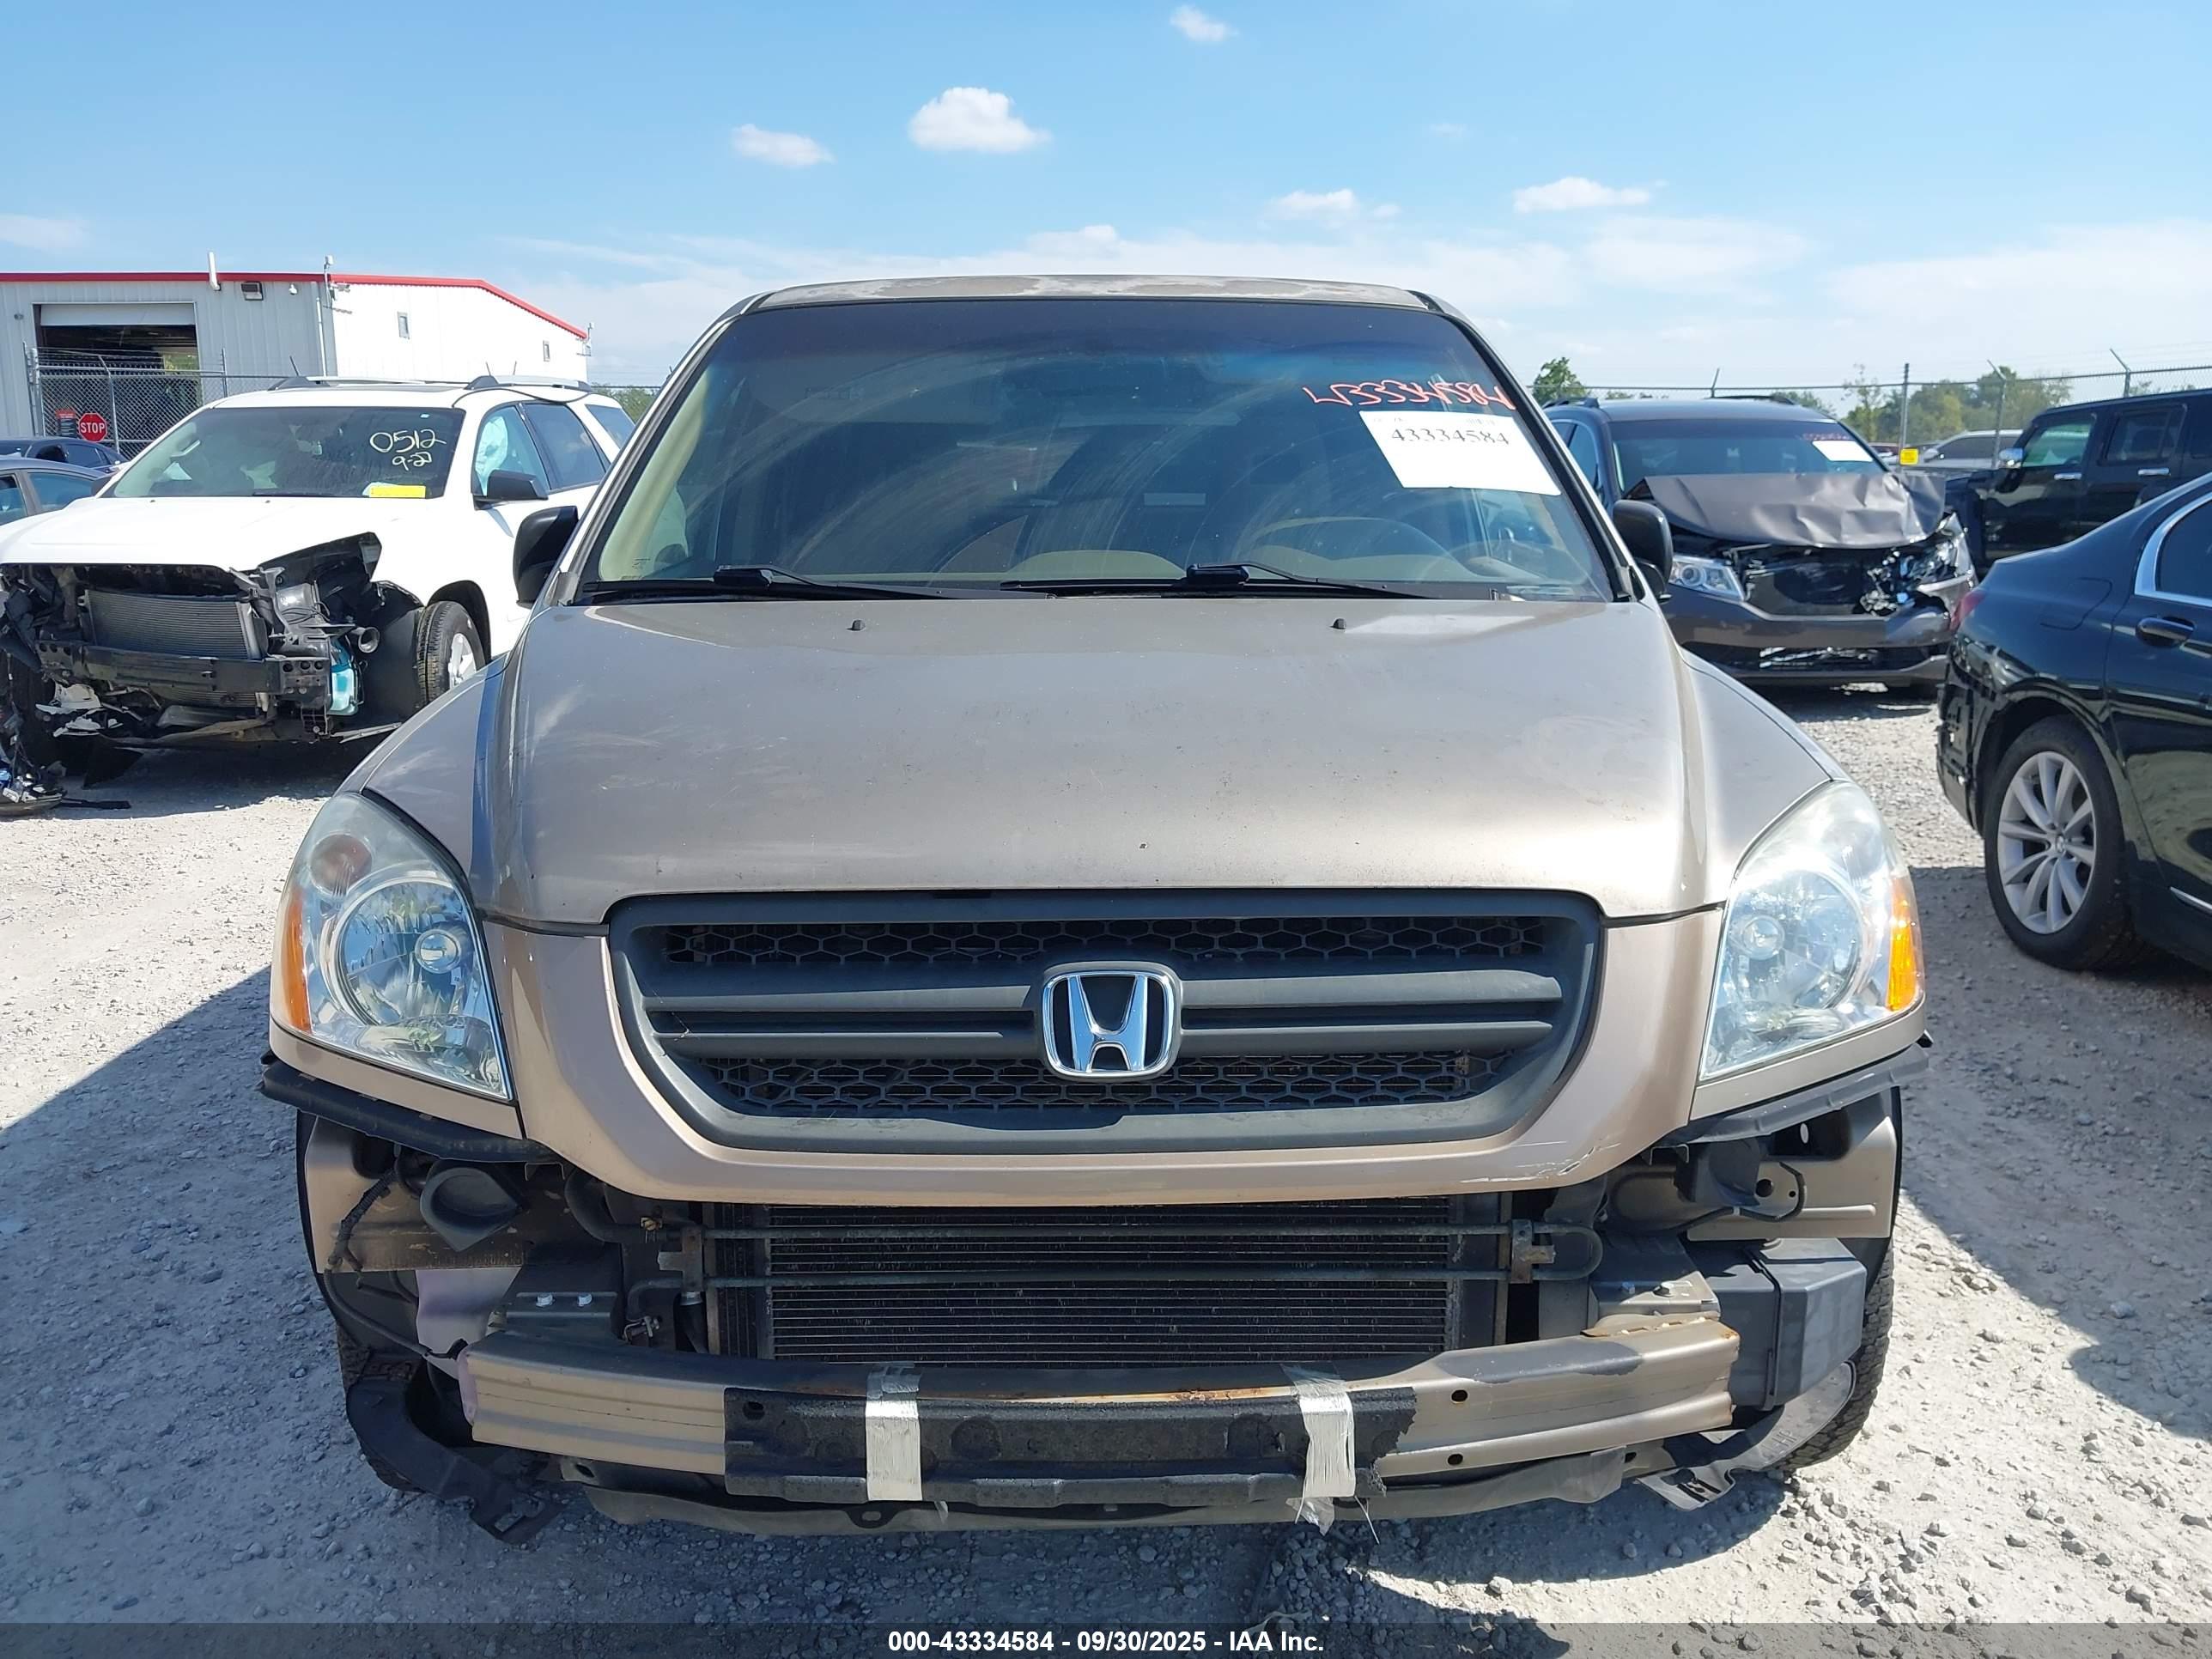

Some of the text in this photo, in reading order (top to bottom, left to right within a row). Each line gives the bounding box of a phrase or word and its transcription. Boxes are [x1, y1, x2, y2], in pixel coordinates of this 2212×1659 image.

[80, 422, 105, 434] STOP
[1390, 428, 1510, 446] 43334584
[369, 428, 447, 453] 0512
